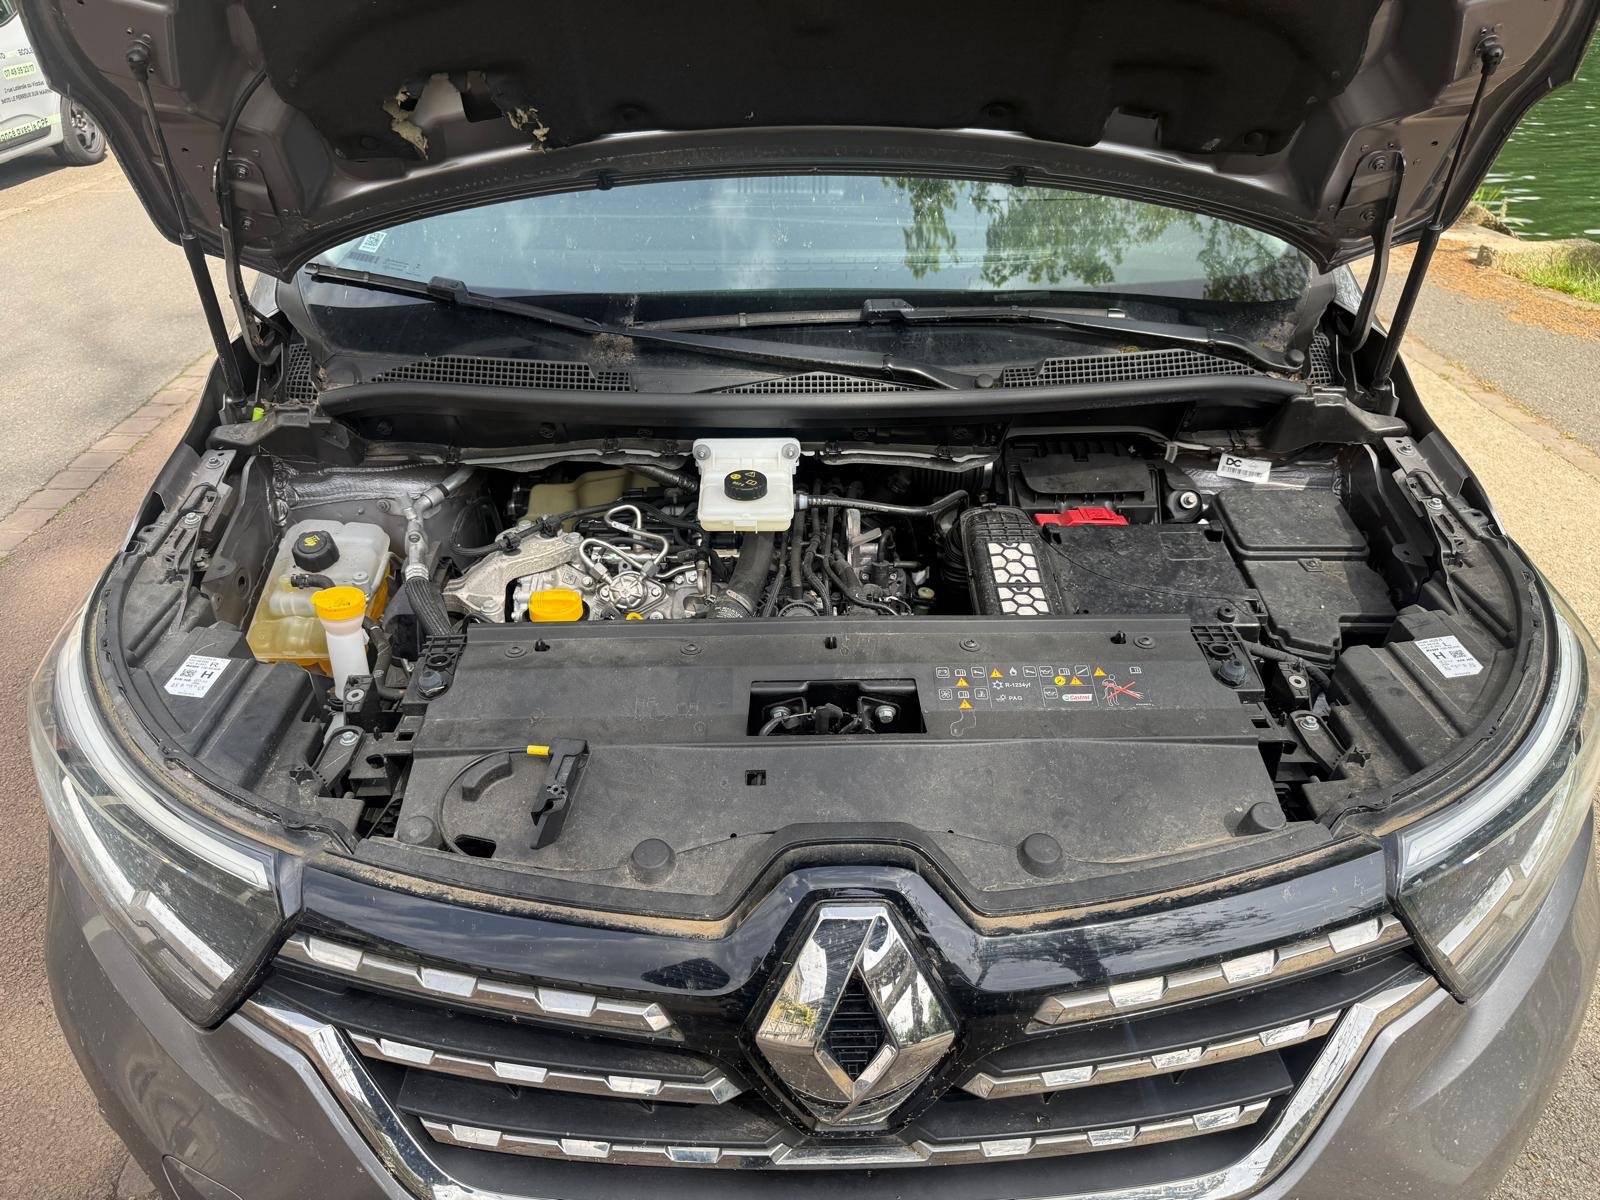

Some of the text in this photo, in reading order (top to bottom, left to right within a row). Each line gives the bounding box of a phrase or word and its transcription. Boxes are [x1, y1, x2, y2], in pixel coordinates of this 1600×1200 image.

[1226, 457, 1242, 467] DC
[1432, 651, 1447, 660] H
[200, 670, 214, 679] H
